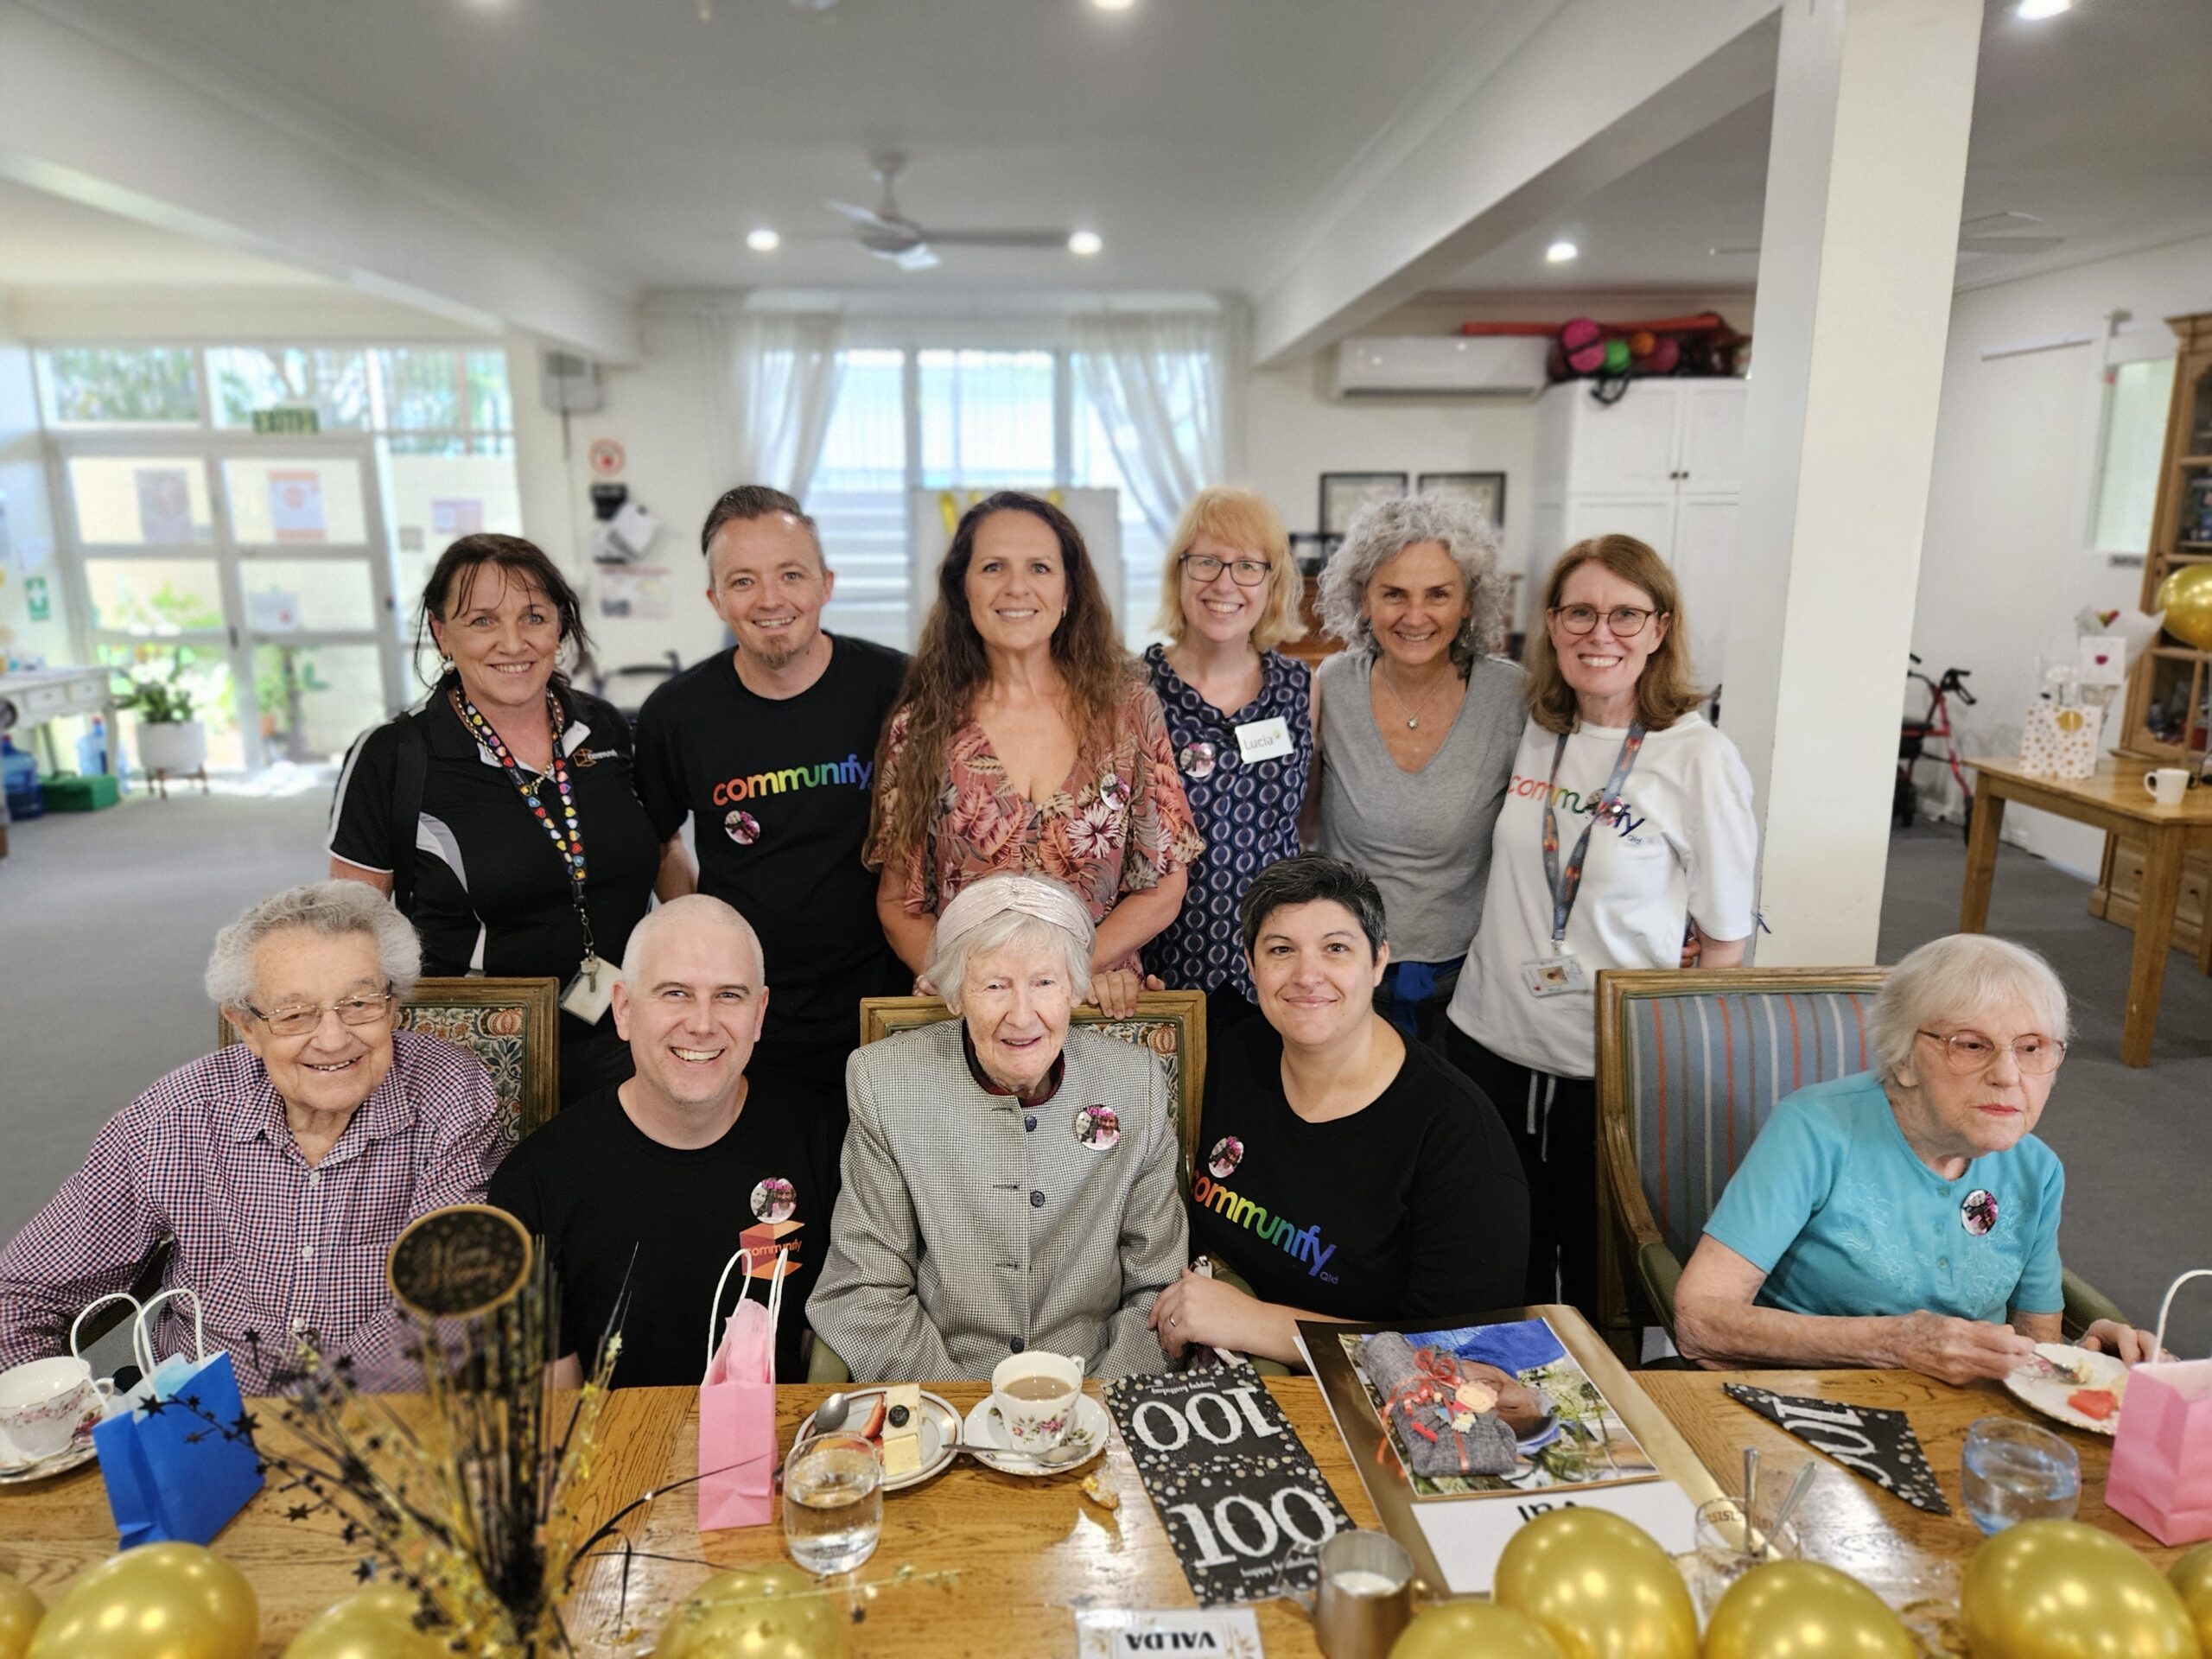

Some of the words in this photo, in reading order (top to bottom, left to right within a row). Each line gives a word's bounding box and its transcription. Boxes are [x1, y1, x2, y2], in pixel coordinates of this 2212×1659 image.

[1243, 734, 1274, 750] Lucia
[1151, 1384, 1189, 1396] birthday
[1188, 1381, 1217, 1391] happy
[1131, 1386, 1283, 1452] 100
[1166, 1485, 1337, 1568] 100
[1125, 1630, 1217, 1650] VALDA
